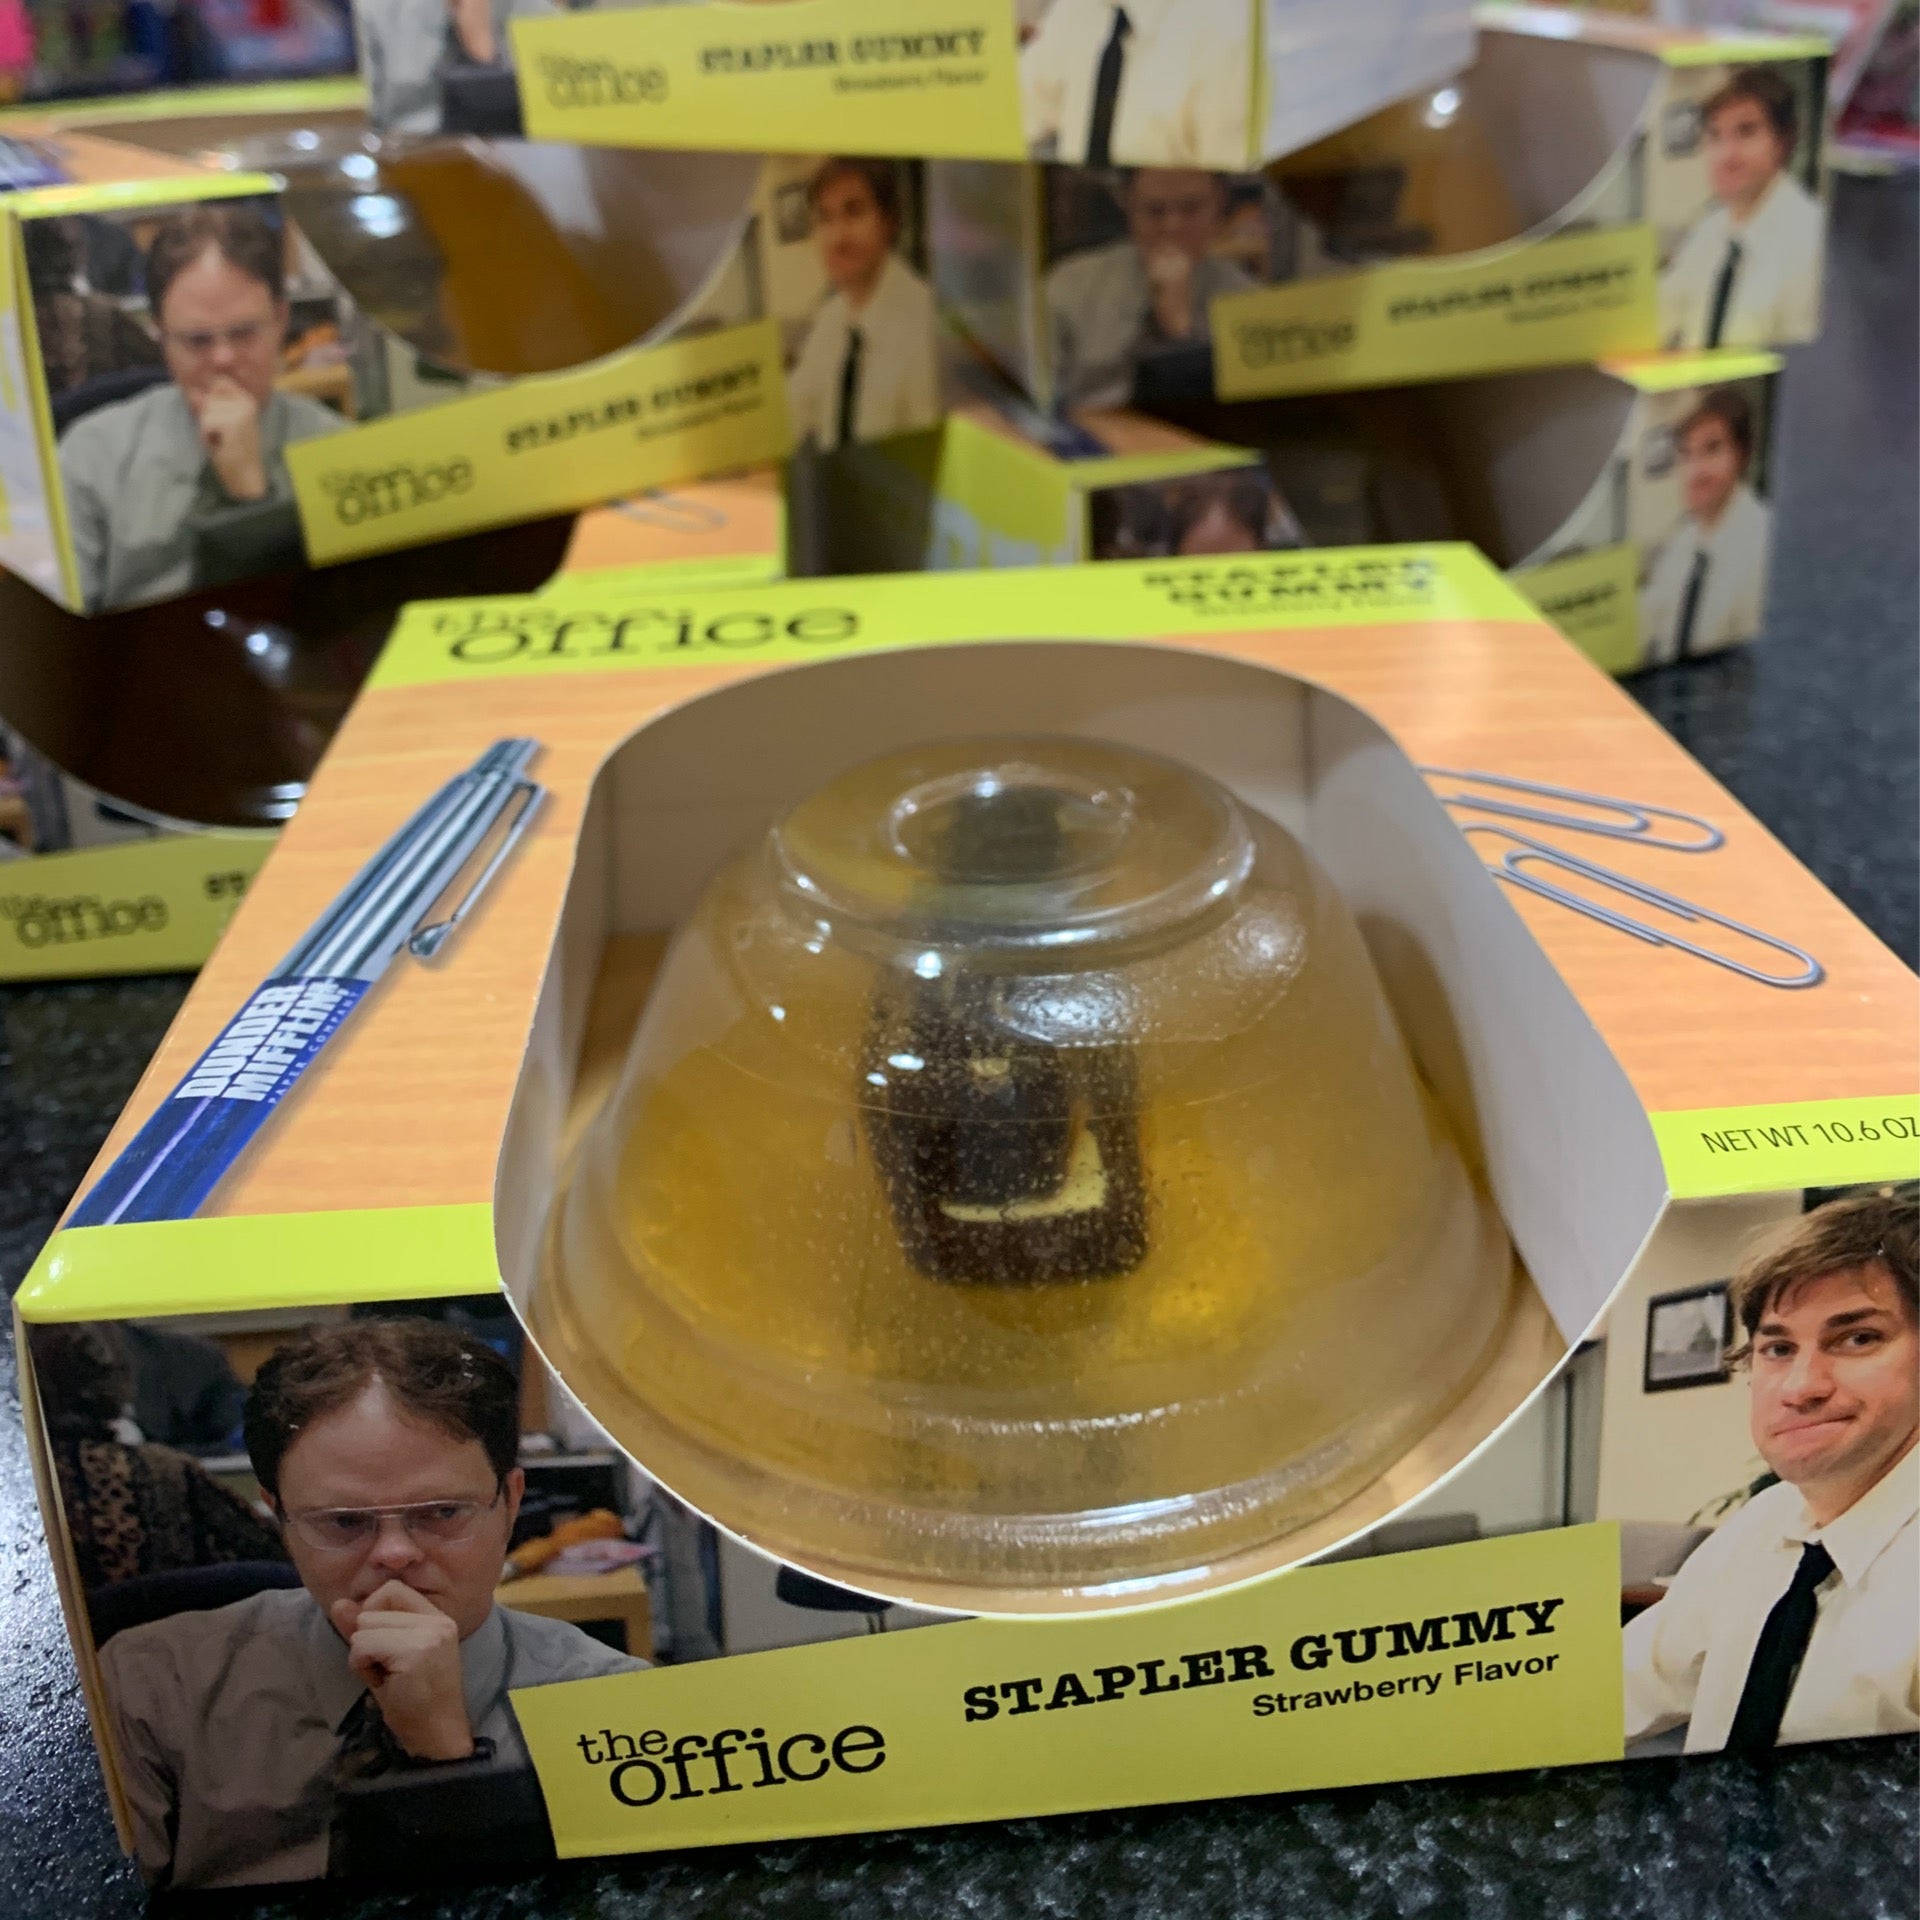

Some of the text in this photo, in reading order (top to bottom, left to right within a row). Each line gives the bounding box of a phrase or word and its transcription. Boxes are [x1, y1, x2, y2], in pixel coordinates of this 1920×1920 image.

[449, 606, 861, 664] office
[173, 982, 306, 1100] DUNDER
[1700, 1128, 1759, 1154] NET
[1757, 1124, 1810, 1148] WT
[1812, 1120, 1881, 1144] 10.6
[964, 1598, 1565, 1723] STAPLER GUMMY
[1252, 1655, 1560, 1718] Strawberry Flavor
[577, 1729, 669, 1765] the
[609, 1725, 886, 1807] office
